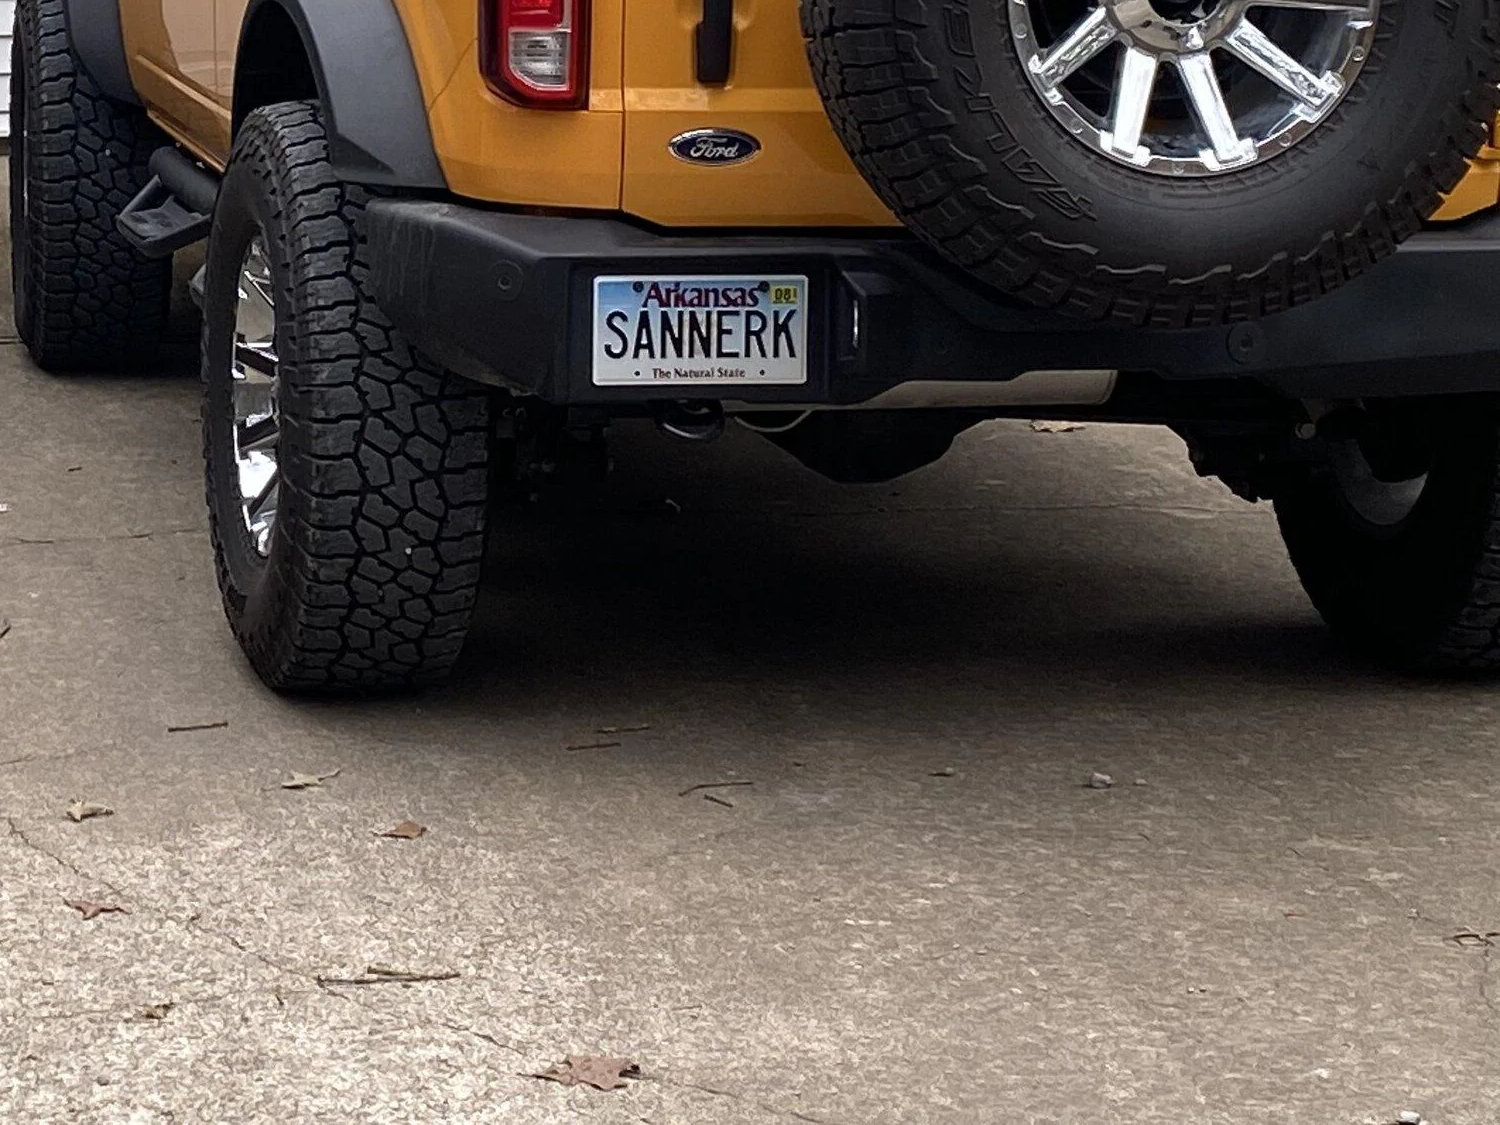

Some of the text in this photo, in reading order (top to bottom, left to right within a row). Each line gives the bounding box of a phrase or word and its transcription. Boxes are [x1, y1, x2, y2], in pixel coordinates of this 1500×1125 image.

[689, 136, 740, 158] Ford
[642, 282, 760, 308] Arkansas
[604, 309, 797, 359] SANNERK
[652, 367, 746, 379] The Natural State
